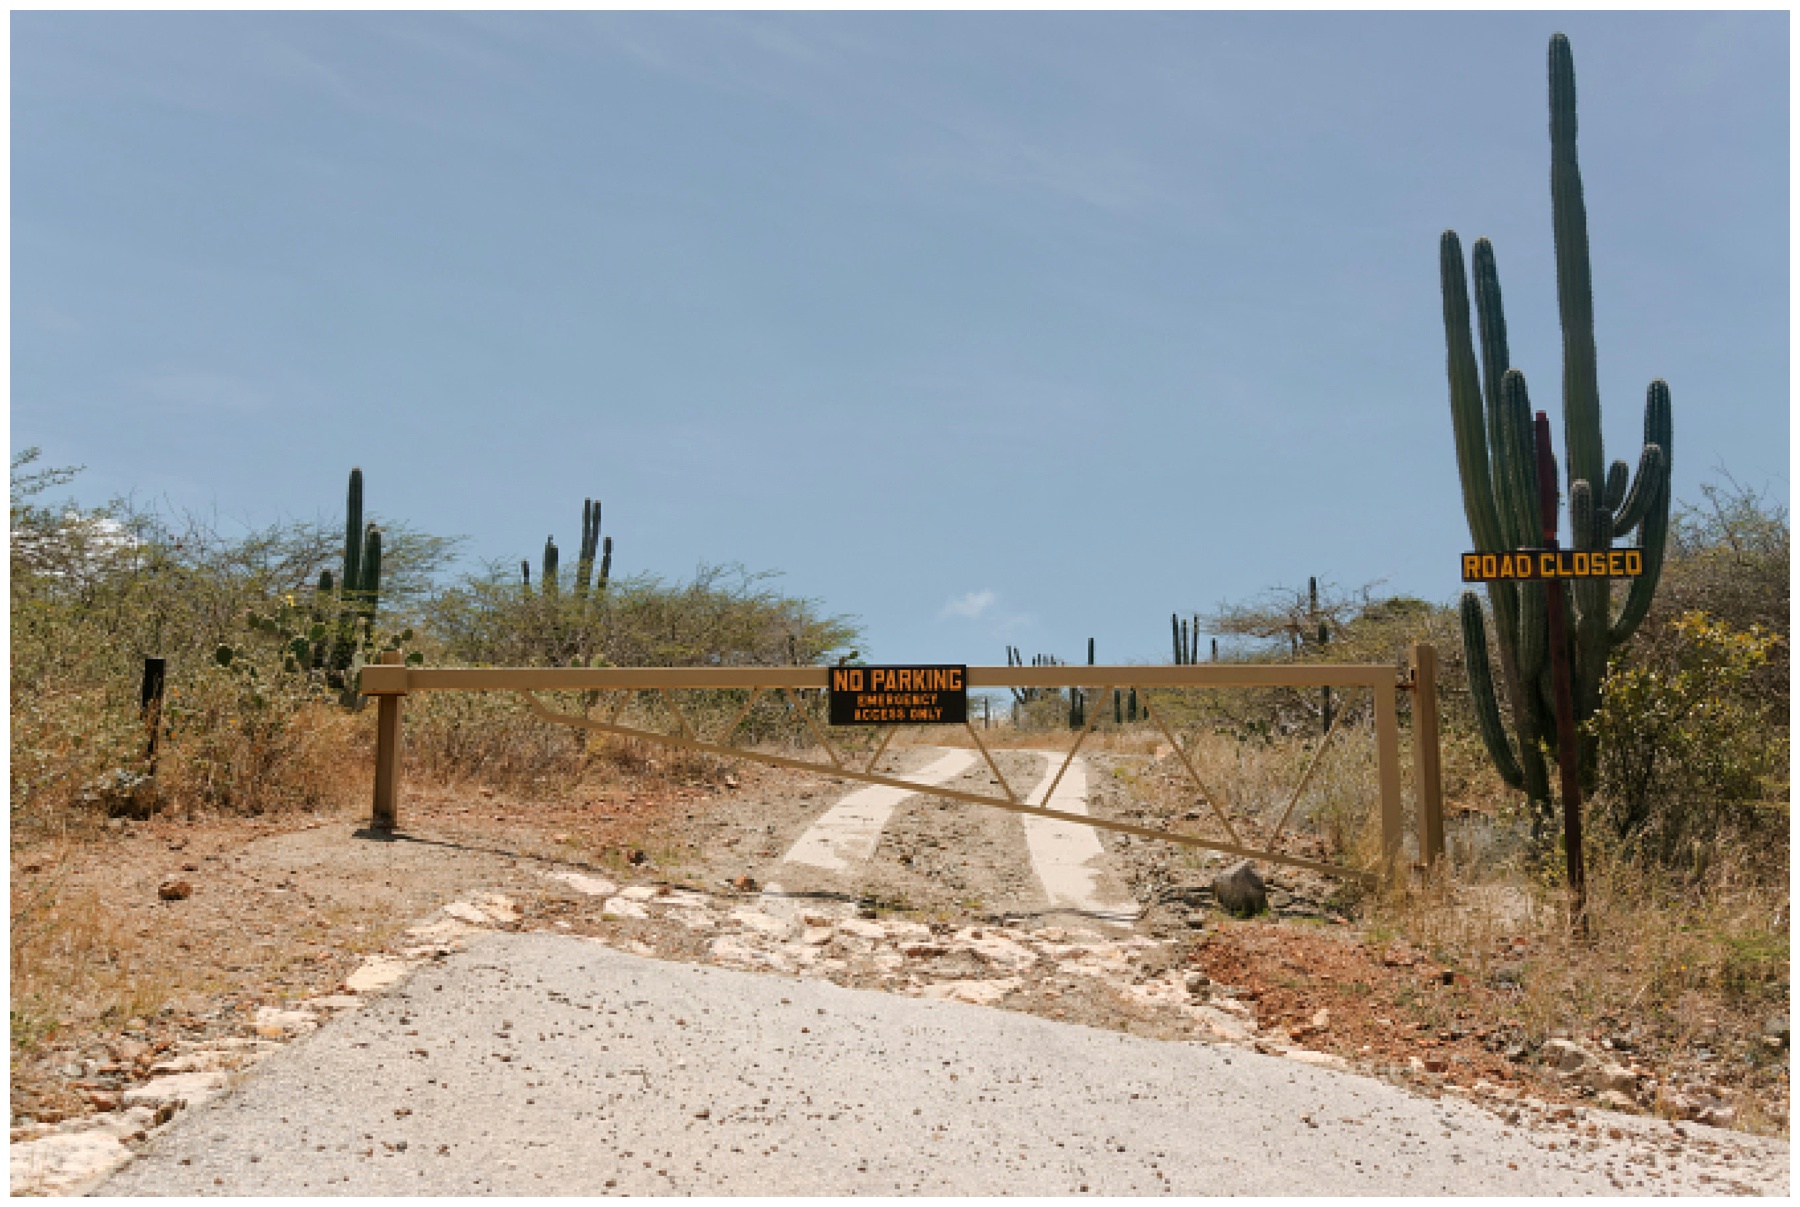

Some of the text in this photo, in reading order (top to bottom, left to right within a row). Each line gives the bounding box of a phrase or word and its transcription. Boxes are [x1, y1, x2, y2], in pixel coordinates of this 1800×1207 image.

[1463, 550, 1643, 578] ROAD CLOSED
[833, 669, 962, 692] NO PARKING
[857, 693, 938, 707] EMERGENCY
[854, 707, 943, 721] ACCESS ONLY
